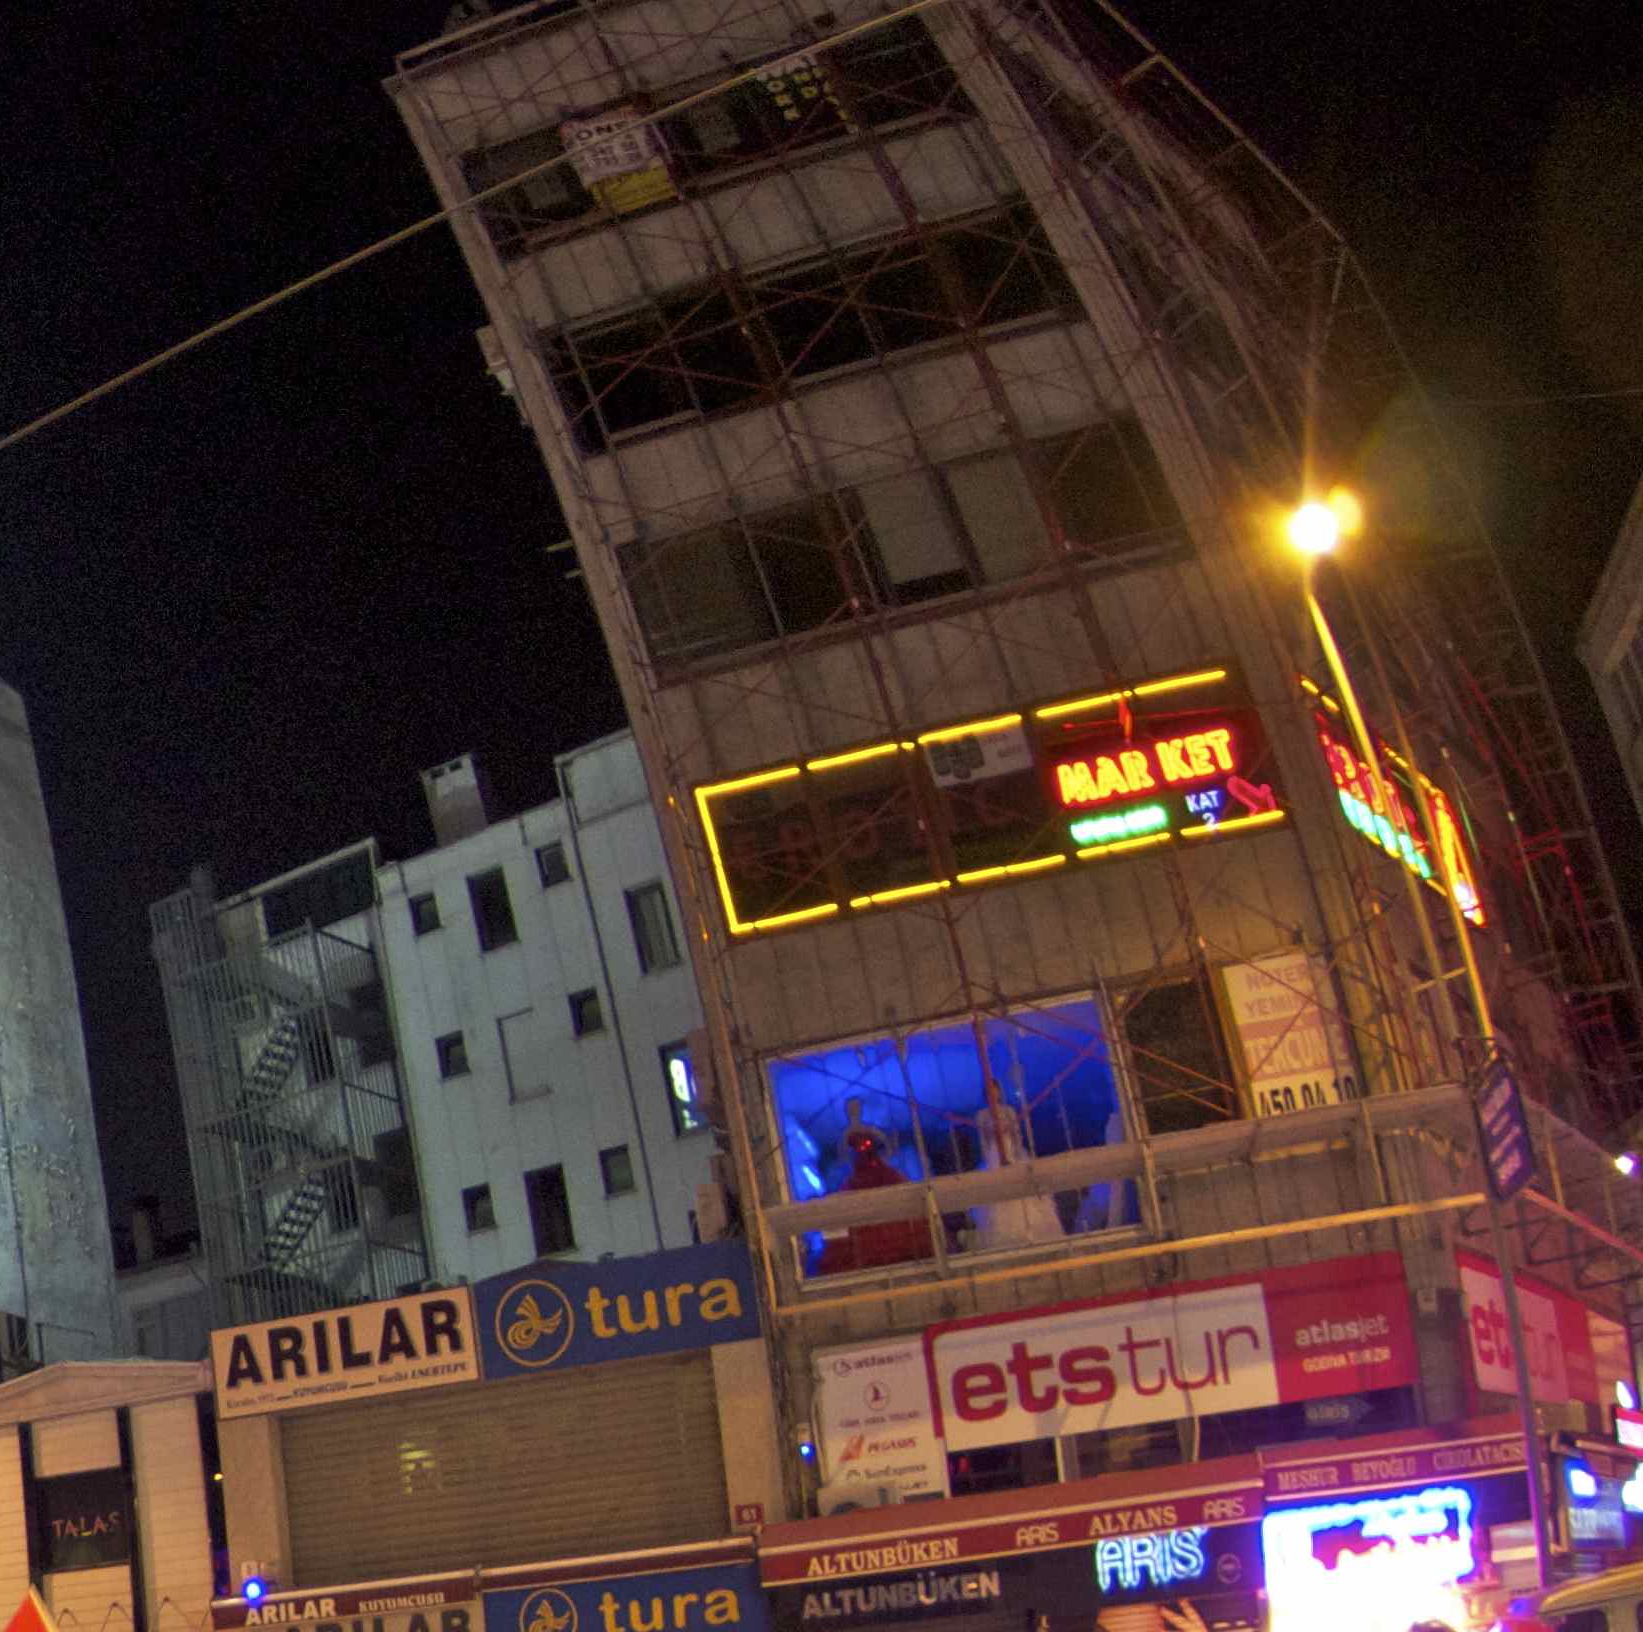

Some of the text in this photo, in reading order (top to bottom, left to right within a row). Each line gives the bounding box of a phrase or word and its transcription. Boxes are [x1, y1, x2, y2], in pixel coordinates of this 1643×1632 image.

[1185, 789, 1220, 813] KAT
[585, 1278, 743, 1339] tura
[226, 1300, 464, 1389] ARILAR
[1088, 1505, 1178, 1537] ALYANS
[807, 1537, 960, 1577] ALTUNBÜKEN
[245, 1598, 337, 1627] ARILAR
[803, 1570, 1001, 1620] ALTUNBÜKEN
